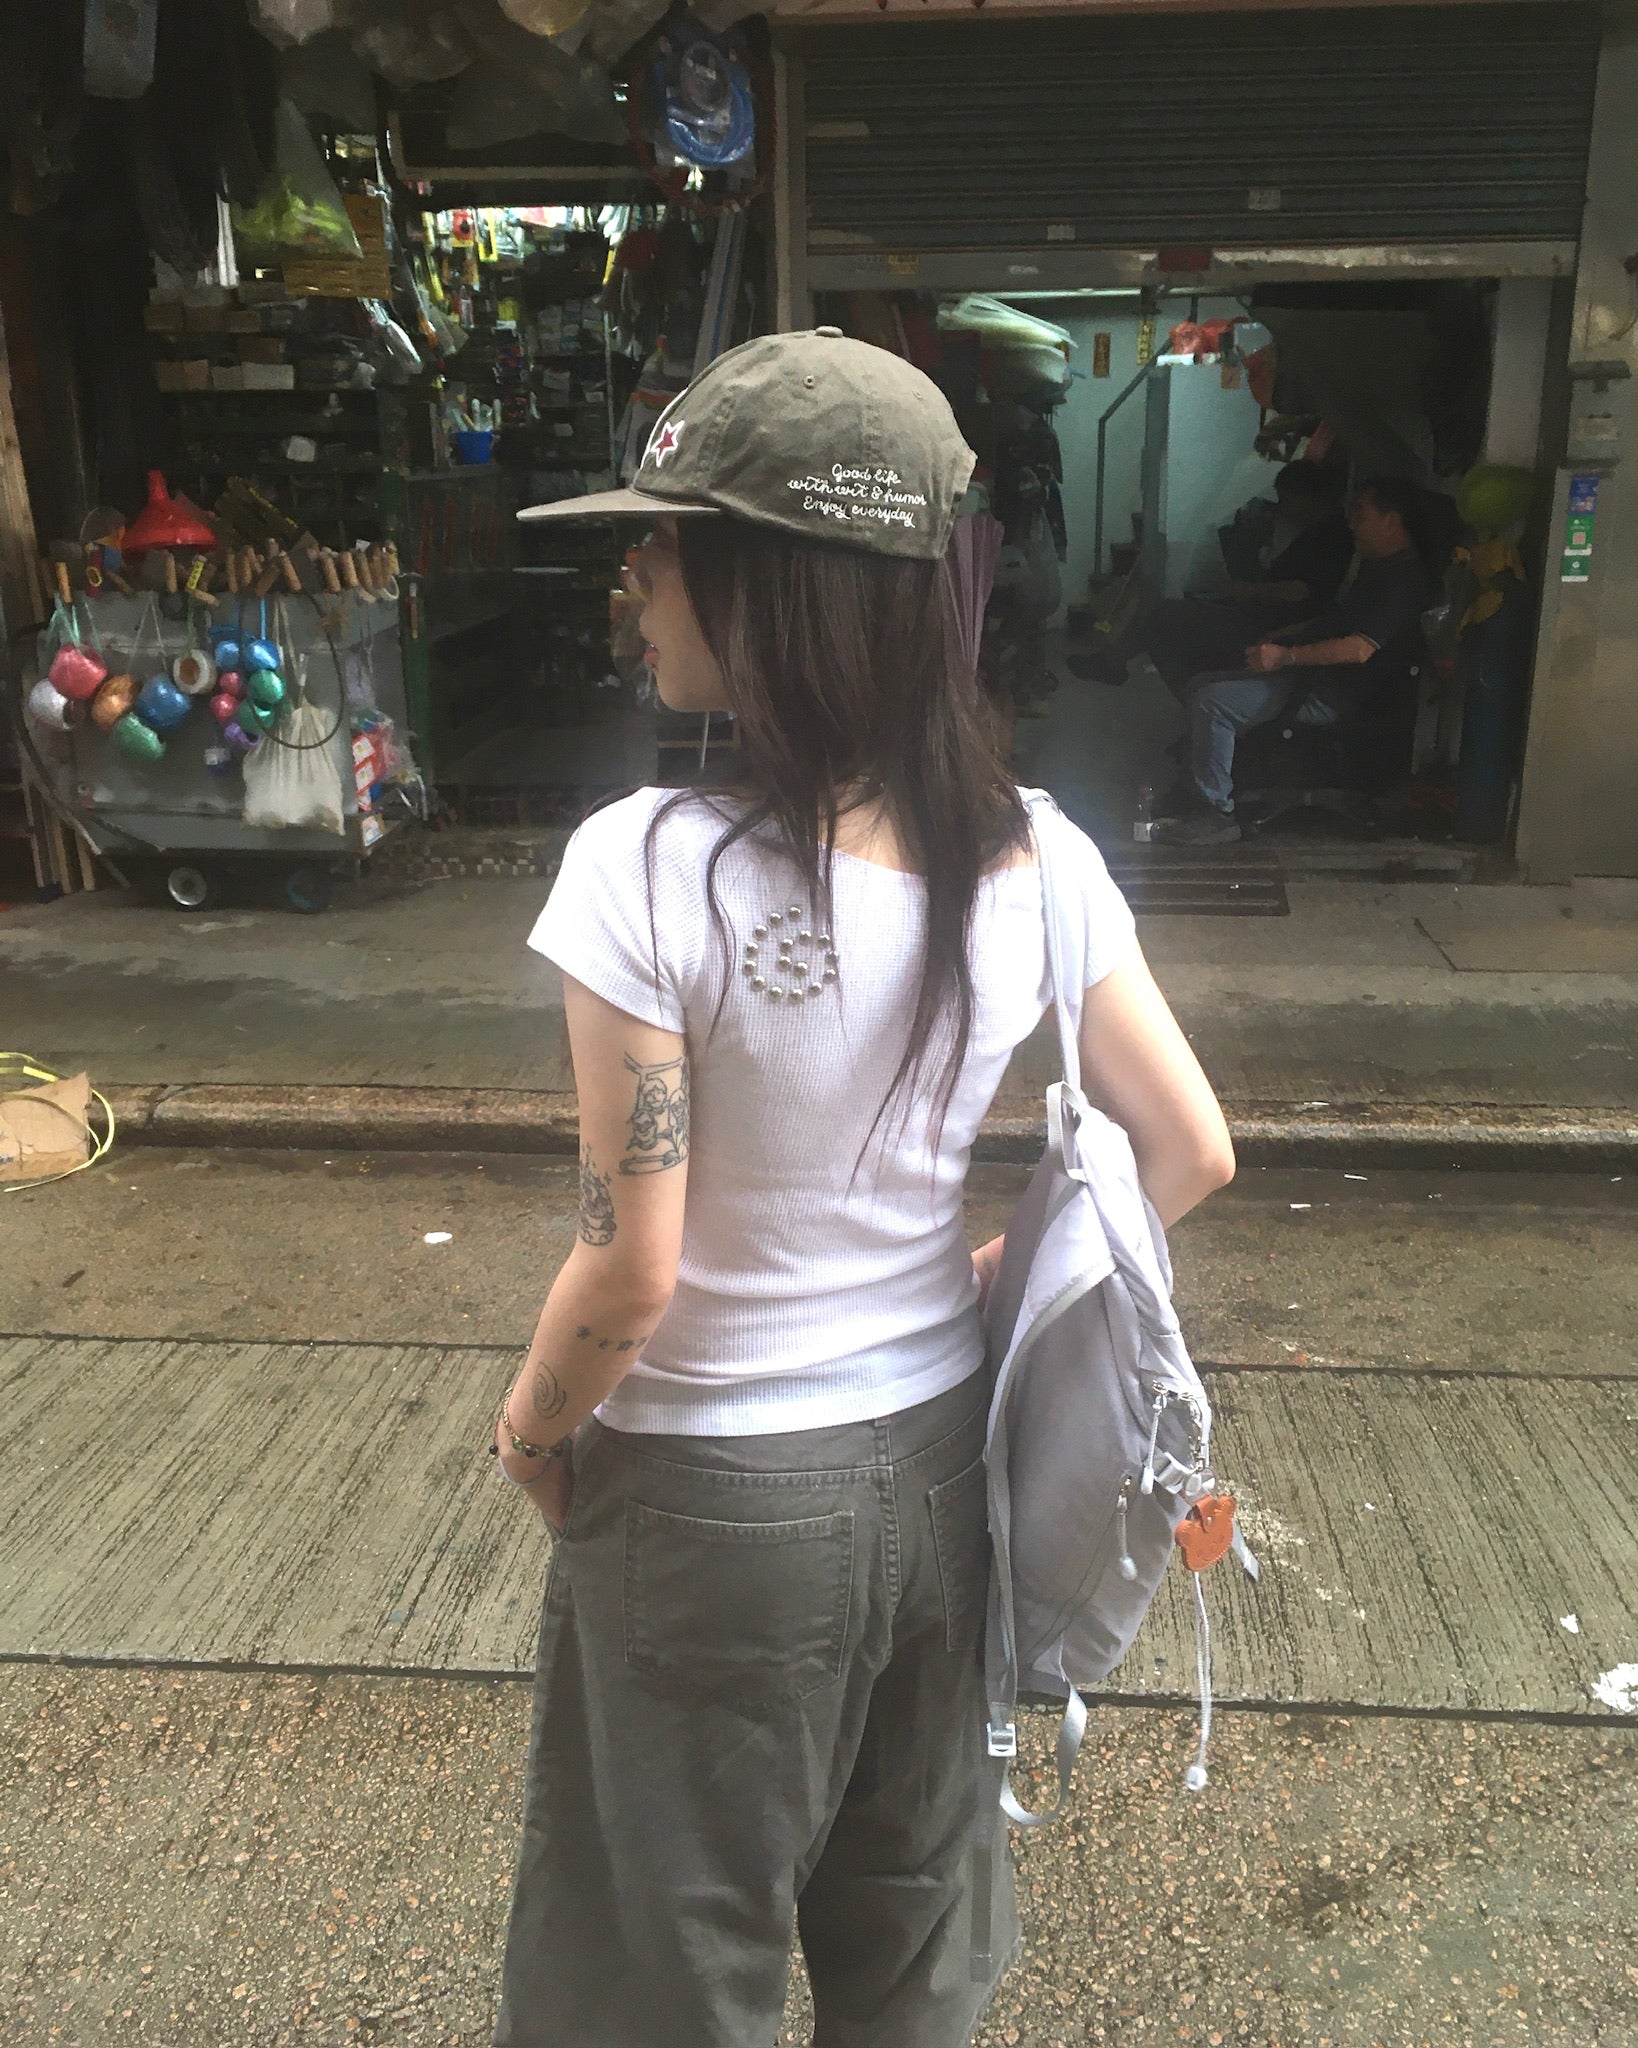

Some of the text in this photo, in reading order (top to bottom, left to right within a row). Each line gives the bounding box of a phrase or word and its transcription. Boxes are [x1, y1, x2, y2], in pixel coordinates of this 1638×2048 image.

[831, 463, 902, 487] Good life
[787, 476, 927, 506] with wit & humor
[803, 496, 915, 528] Enjoy everyday
